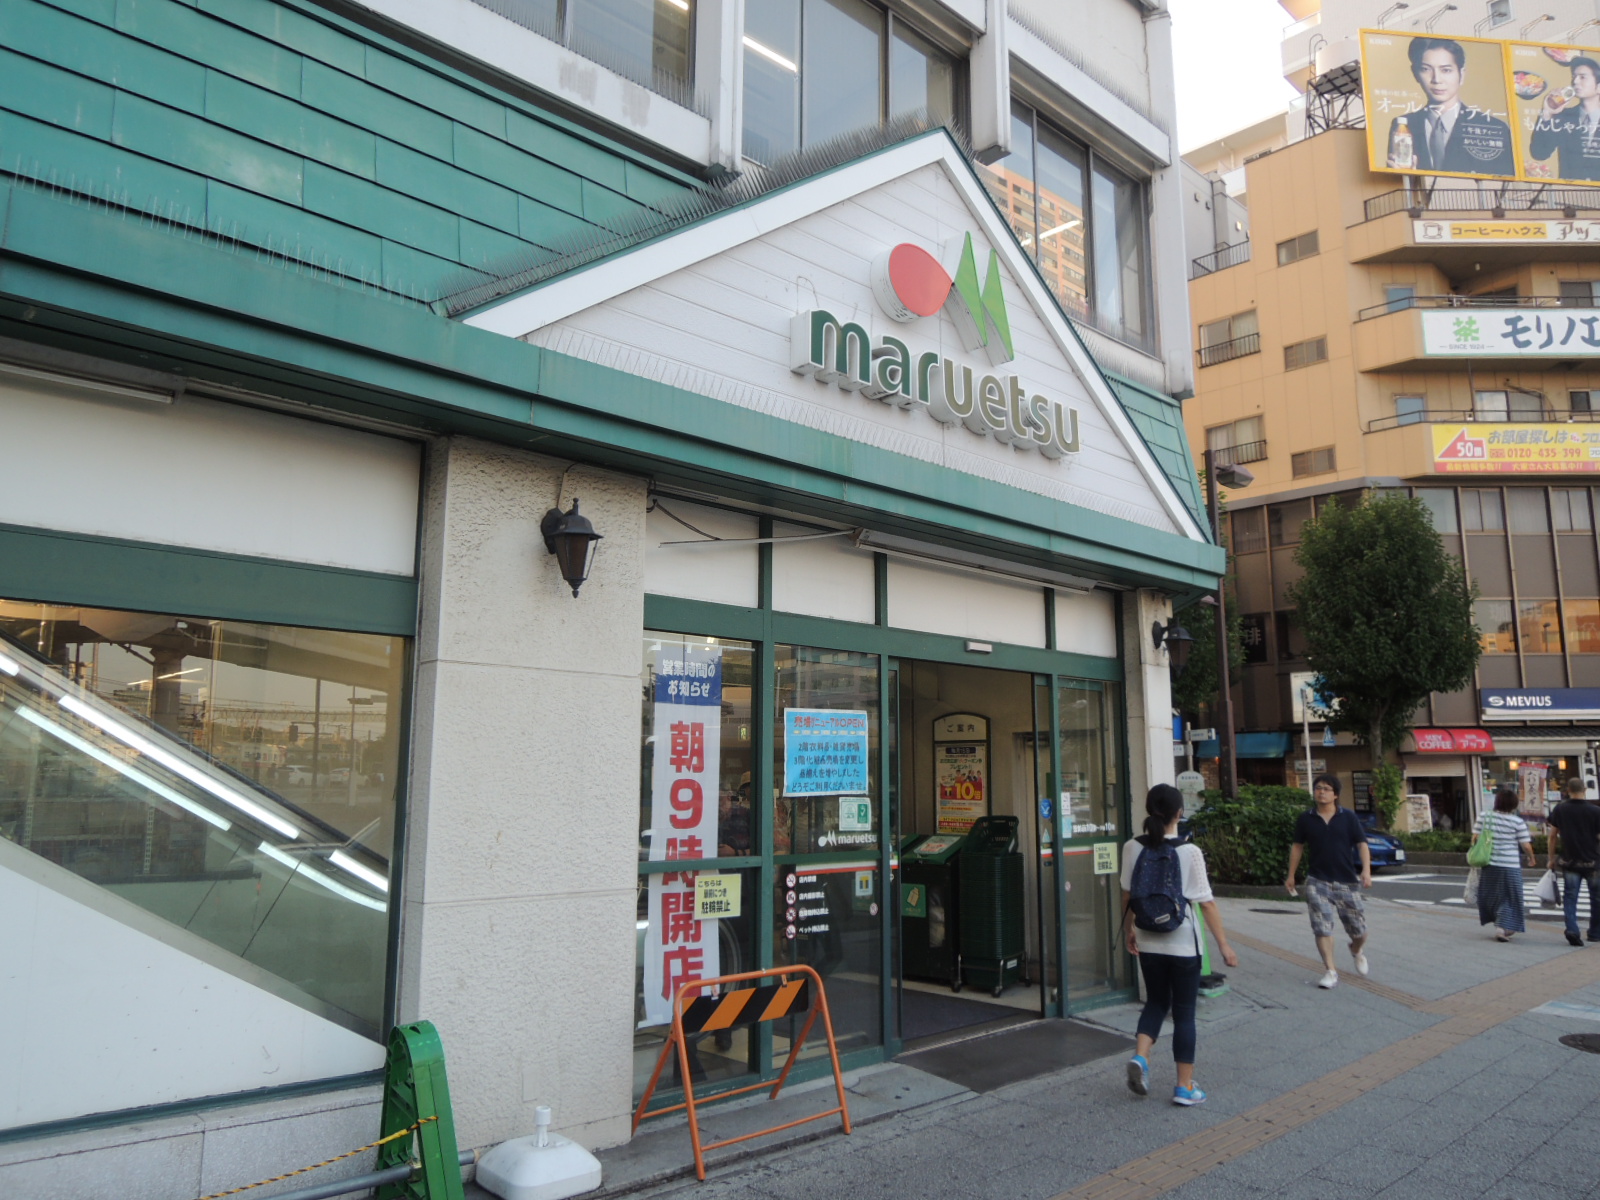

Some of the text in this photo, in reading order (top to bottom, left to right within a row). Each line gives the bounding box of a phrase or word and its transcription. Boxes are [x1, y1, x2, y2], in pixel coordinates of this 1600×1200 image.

[1452, 226, 1546, 236] コーヒーハウス
[1452, 315, 1480, 342] 茶
[810, 309, 1081, 455] maruetsu
[1488, 430, 1569, 444] お部屋探しは
[1456, 441, 1483, 457] 50m
[662, 659, 716, 679] 営業時間の
[667, 679, 711, 698] お知らせ
[1505, 695, 1552, 707] MEVIUS
[946, 724, 976, 733] ご案内
[1419, 741, 1453, 749] COFFEE
[838, 833, 877, 845] maruetsu
[697, 880, 722, 888] こちらは
[701, 899, 731, 915] 駐輪禁止
